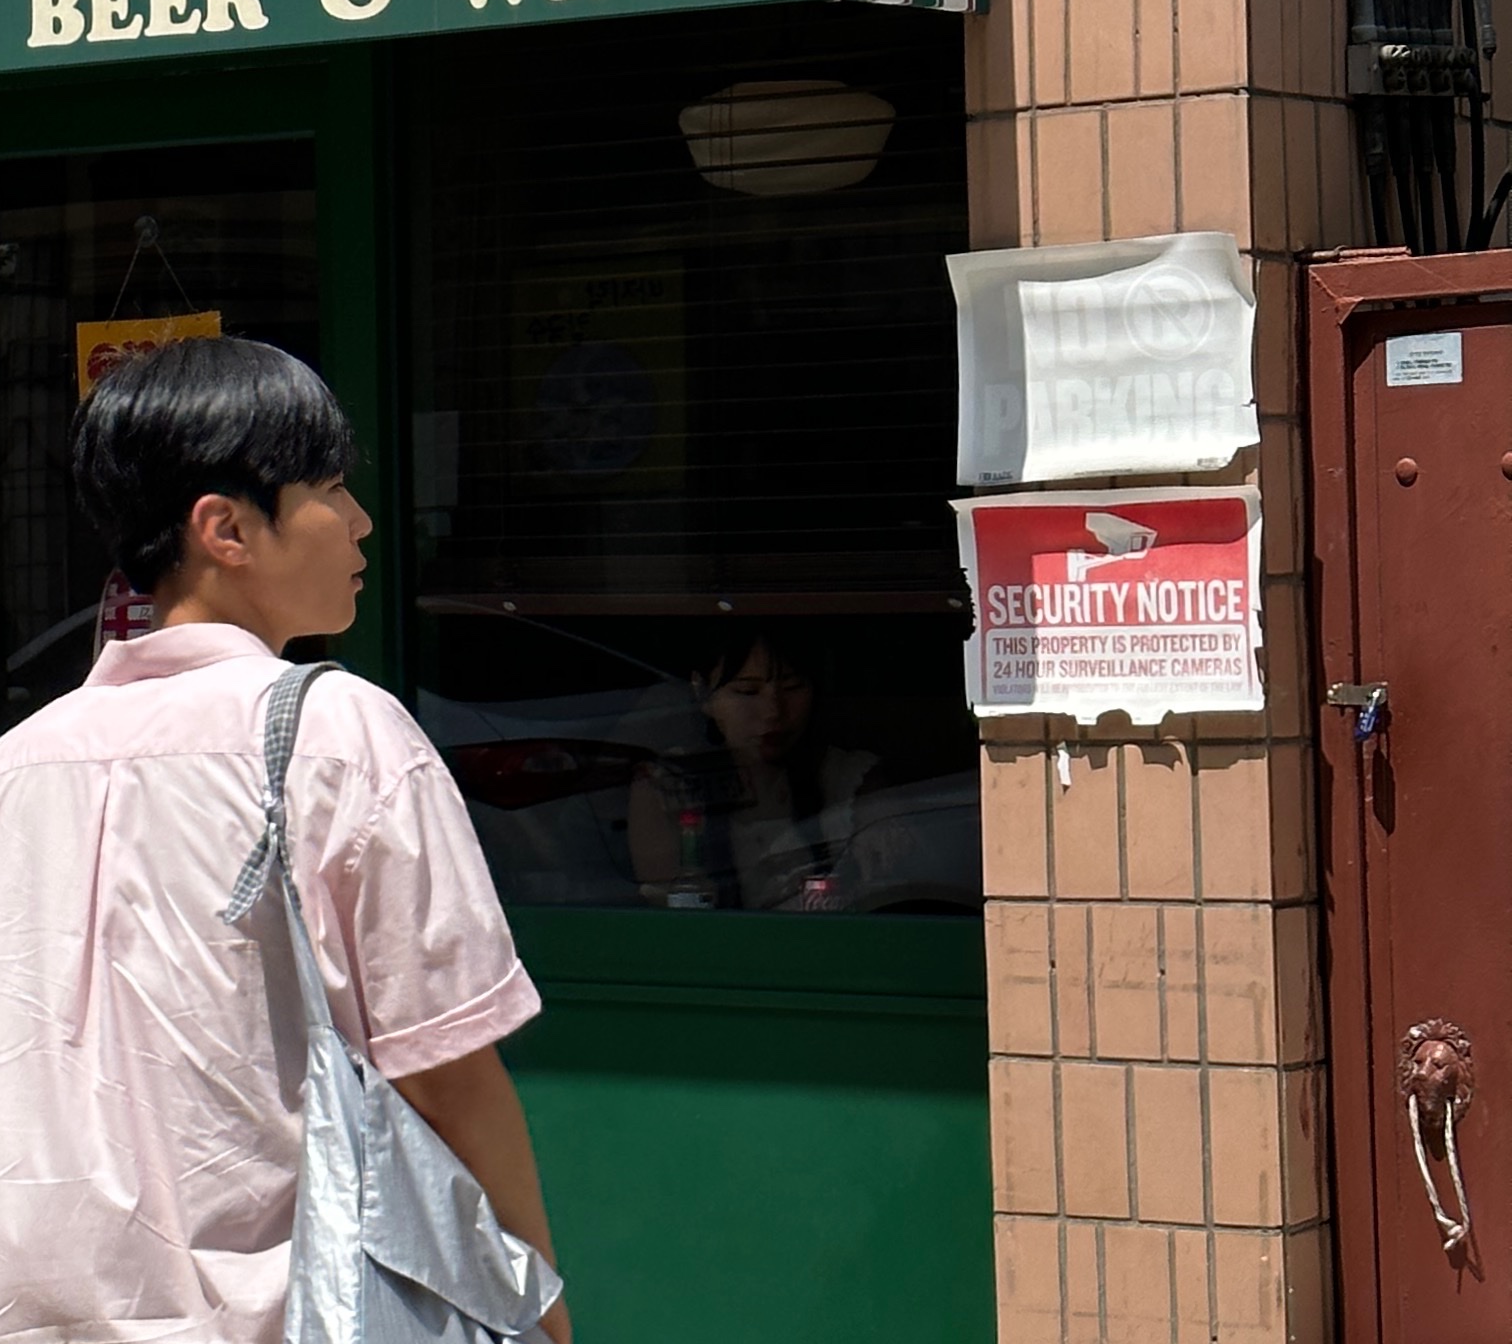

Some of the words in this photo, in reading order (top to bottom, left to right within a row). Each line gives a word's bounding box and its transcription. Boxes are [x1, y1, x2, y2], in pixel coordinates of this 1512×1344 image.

[984, 368, 1236, 455] PARKING
[988, 582, 1131, 626] SECURITY
[1136, 579, 1244, 623] NOTICE
[993, 636, 1028, 655] THIS
[1031, 634, 1110, 655] PROPERTY
[1112, 634, 1127, 653] IS
[1130, 633, 1221, 653] PROTECTED
[1223, 633, 1241, 652] BY
[993, 660, 1012, 679] 24
[1015, 660, 1056, 679] HOUR
[1059, 658, 1167, 678] SURVEILLANCE
[1171, 657, 1243, 677] CAMERAS
